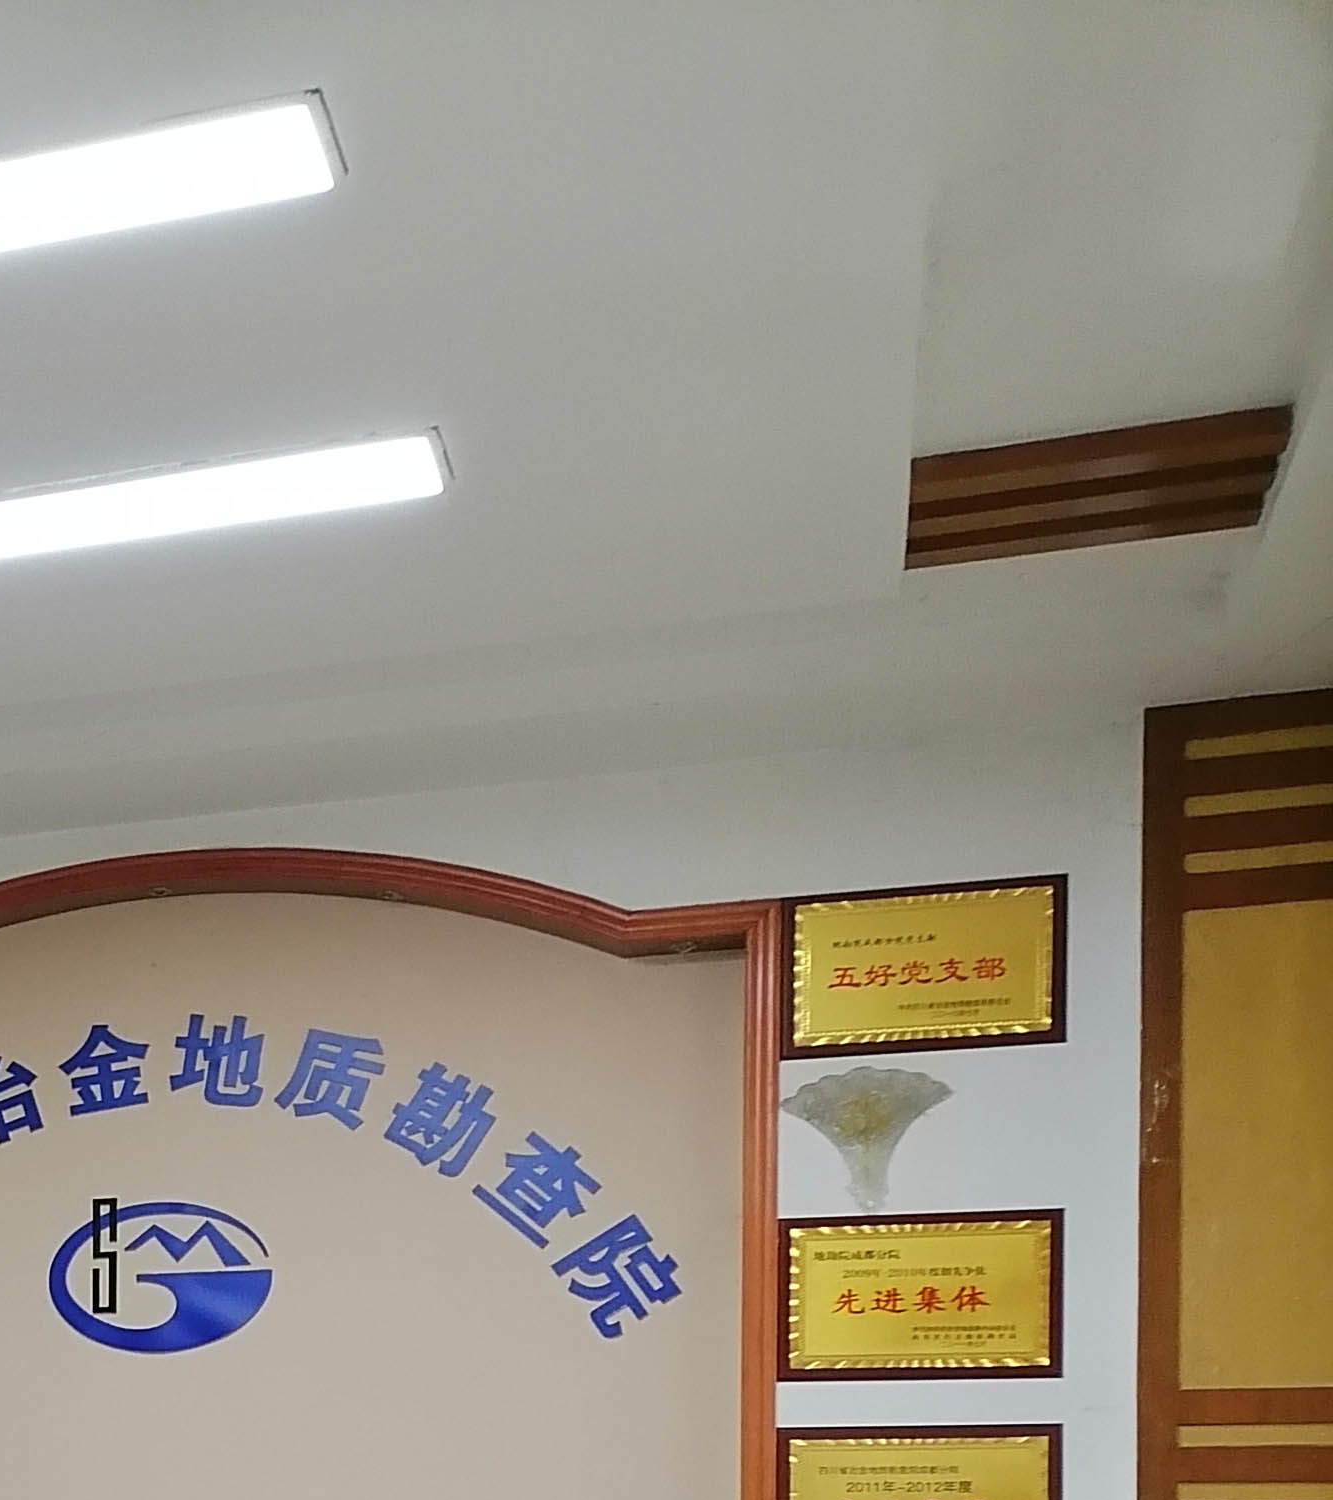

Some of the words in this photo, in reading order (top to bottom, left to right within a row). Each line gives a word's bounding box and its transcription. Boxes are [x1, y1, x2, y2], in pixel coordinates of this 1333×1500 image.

[827, 956, 1007, 989] 五好党支部
[832, 1286, 990, 1314] 先进集体
